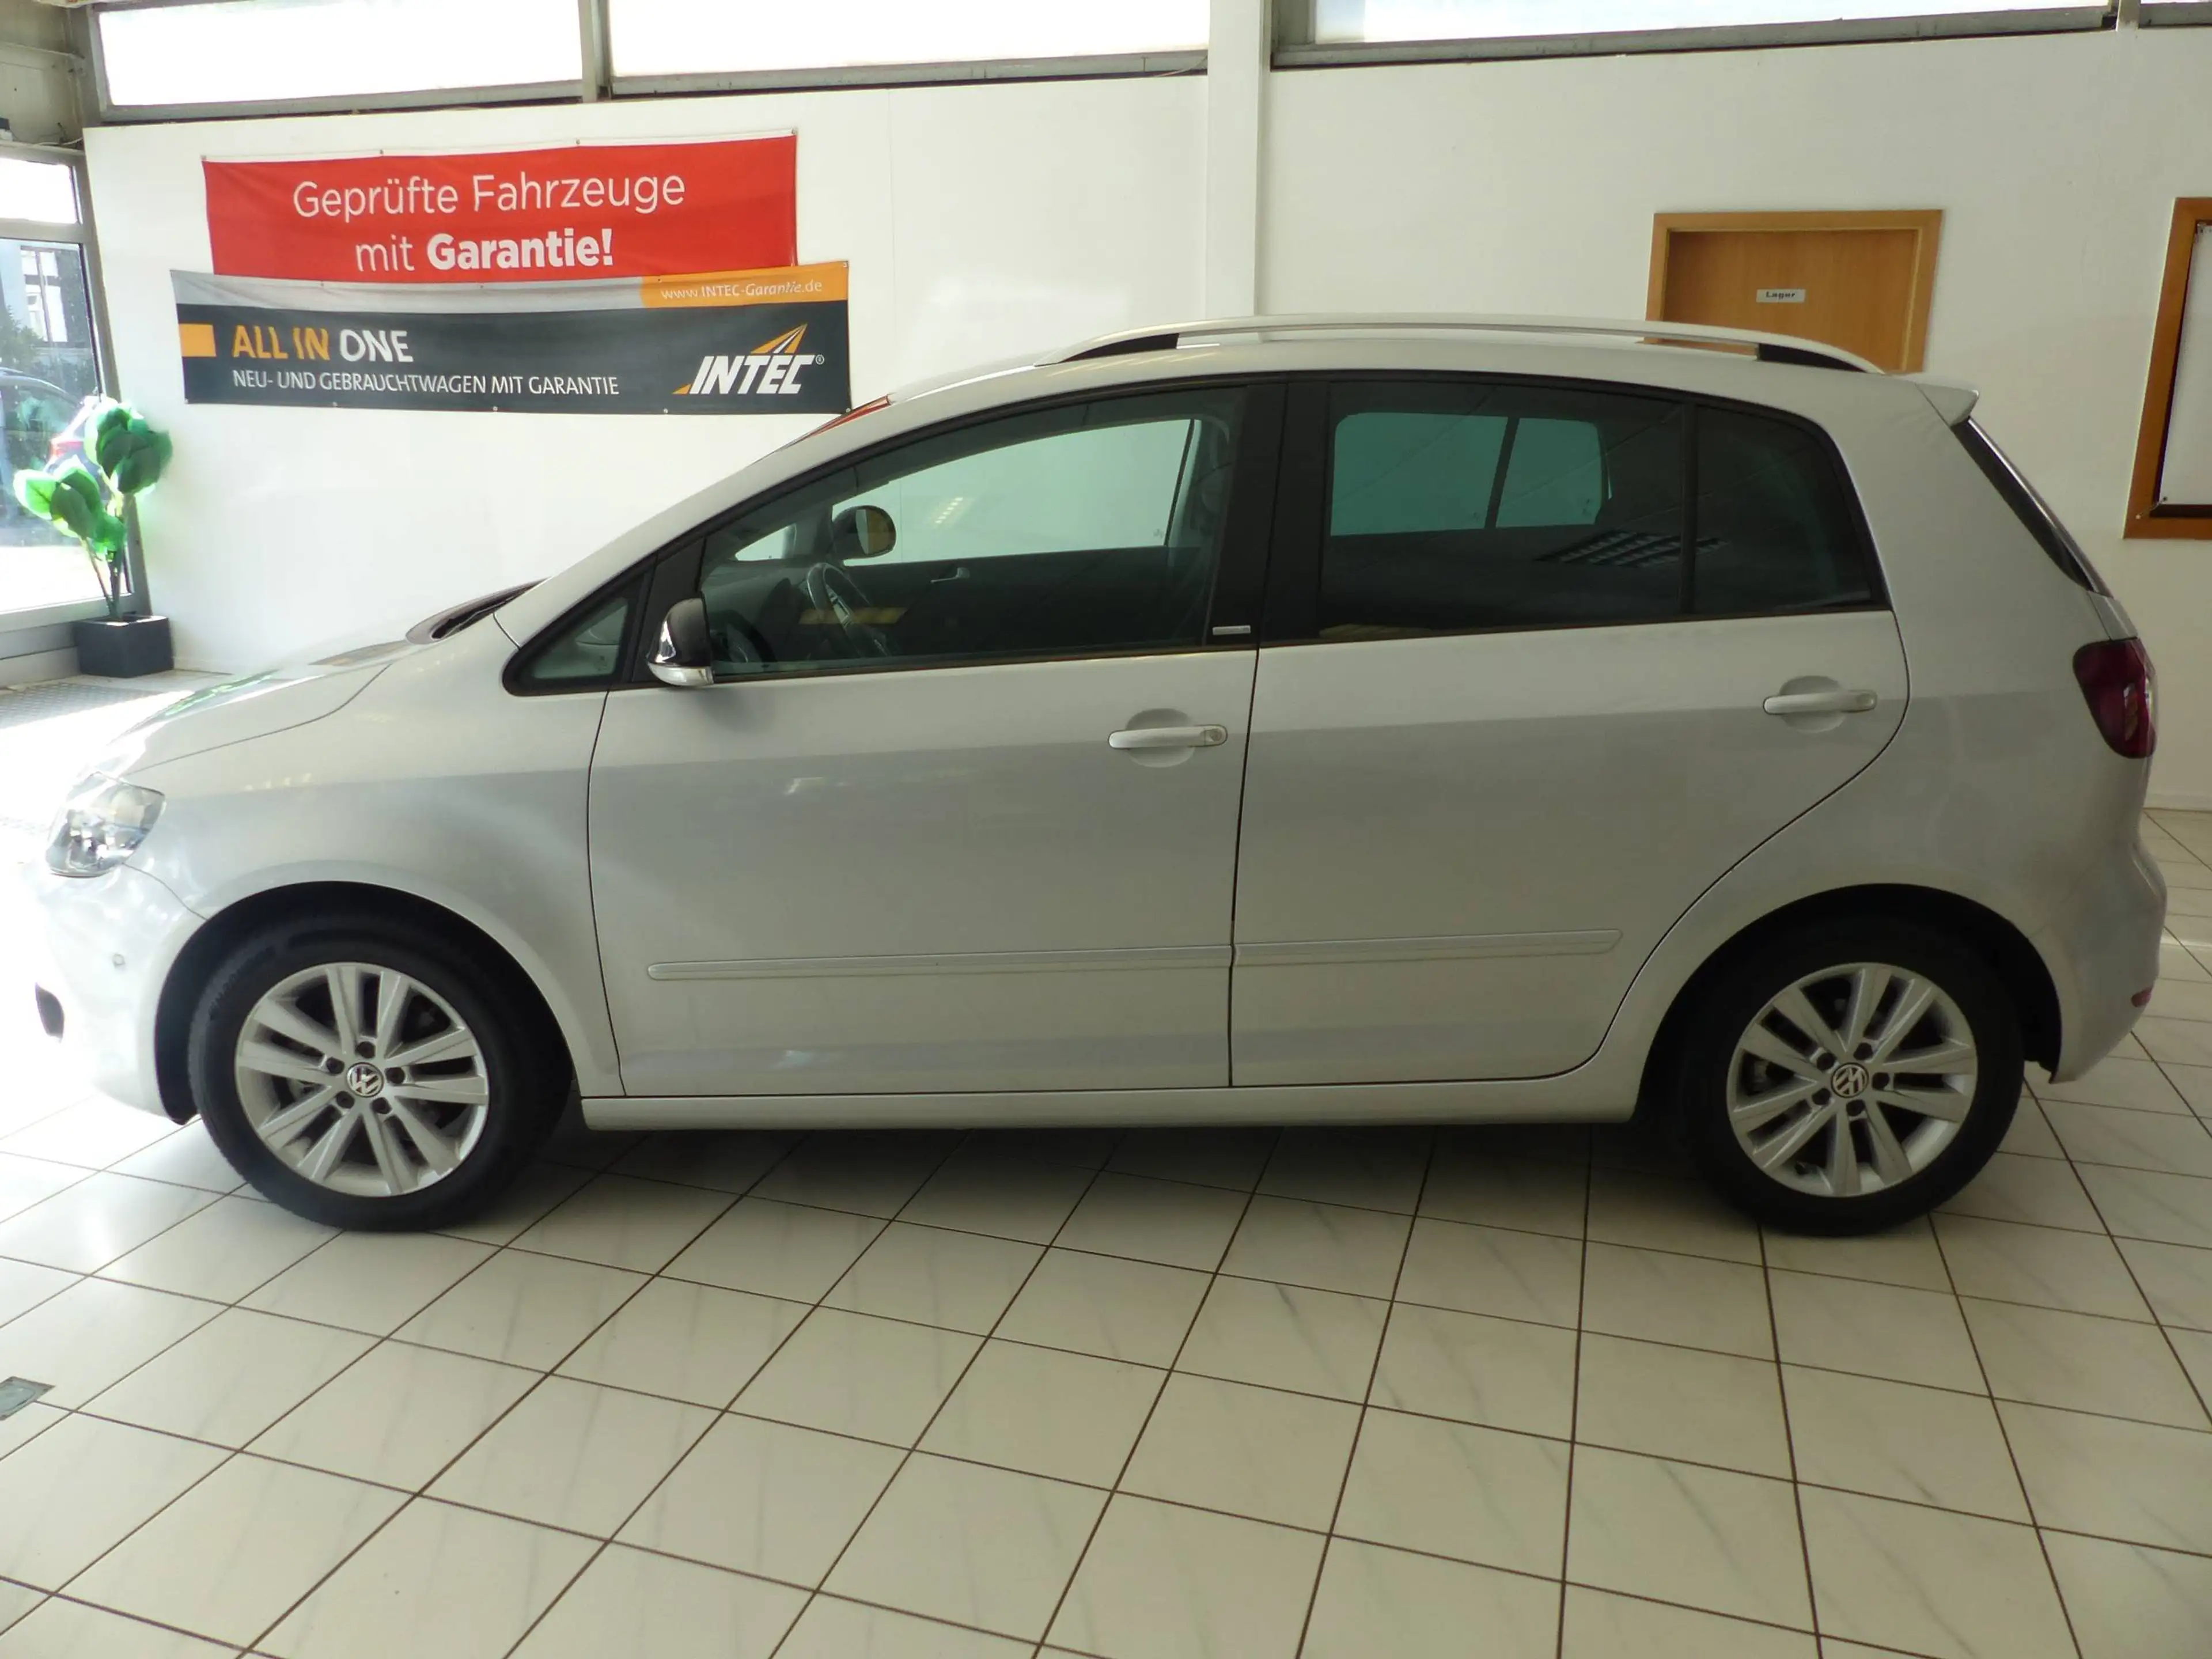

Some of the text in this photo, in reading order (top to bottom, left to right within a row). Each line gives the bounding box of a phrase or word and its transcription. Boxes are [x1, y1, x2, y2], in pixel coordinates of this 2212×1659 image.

[293, 171, 685, 223] Geprüfte Fahrzeuge
[356, 228, 613, 271] mit Garantie!
[661, 279, 823, 299] www.INTEC-Garantie.de
[232, 325, 414, 362] ALL IN ONE
[233, 370, 620, 395] NEU- UND GEBRAUCHTWAGEN MIT GARANTIE
